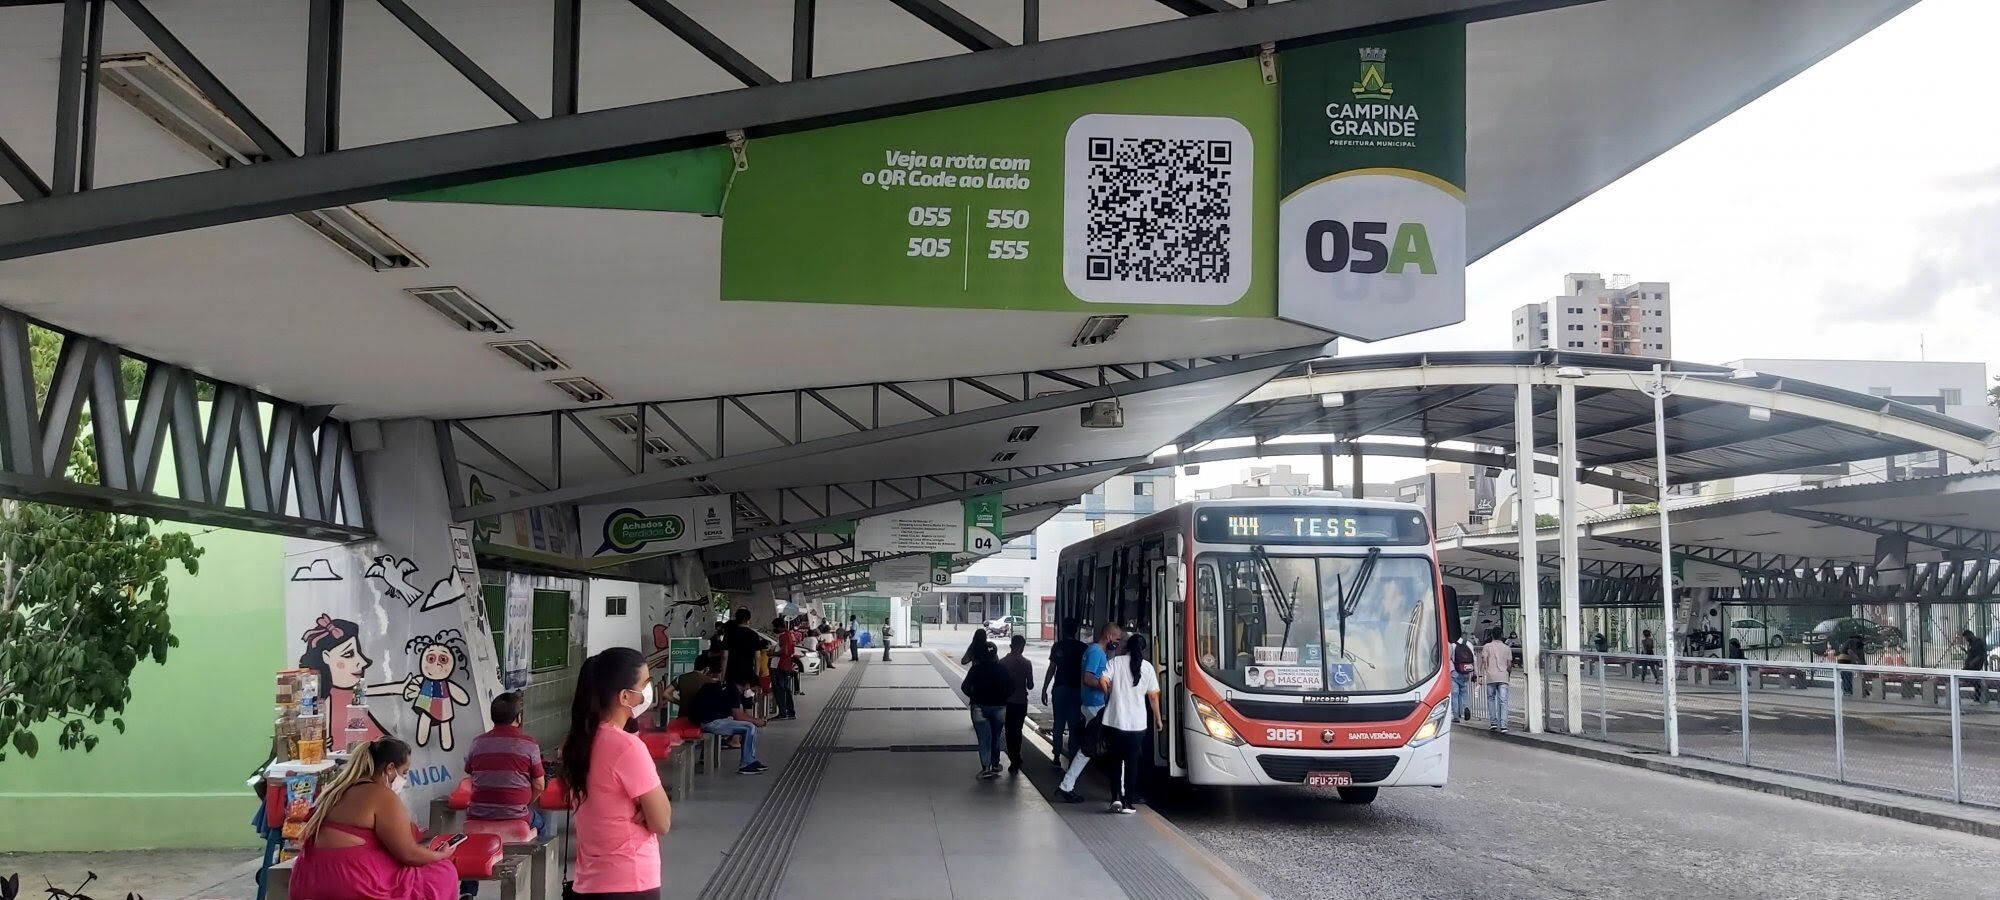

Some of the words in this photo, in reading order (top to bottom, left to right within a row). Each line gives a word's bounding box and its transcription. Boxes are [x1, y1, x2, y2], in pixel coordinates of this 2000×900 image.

[1326, 103, 1419, 120] CAMPINA
[1330, 120, 1416, 137] GRANDE
[1329, 139, 1374, 147] PREFEITURA
[886, 150, 927, 171] Veja
[930, 155, 943, 168] a
[945, 154, 987, 170] rota
[989, 157, 1030, 171] com
[862, 171, 875, 185] o
[878, 169, 906, 191] QR
[909, 170, 957, 188] Code
[959, 175, 984, 189] ao
[986, 173, 1030, 190] lado
[908, 206, 952, 227] 055
[986, 209, 1030, 229] 550
[906, 237, 951, 257] 505
[987, 240, 1029, 260] 555
[1305, 219, 1437, 275] 05A
[622, 521, 663, 531] Achados
[664, 520, 677, 534] &
[622, 528, 665, 538] Perdidos
[1228, 516, 1259, 535] 444
[1293, 518, 1356, 537] TESS
[975, 538, 992, 549] 04
[936, 574, 947, 582] 03
[1266, 728, 1302, 741] 3051
[1370, 731, 1401, 740] VERÔNICA
